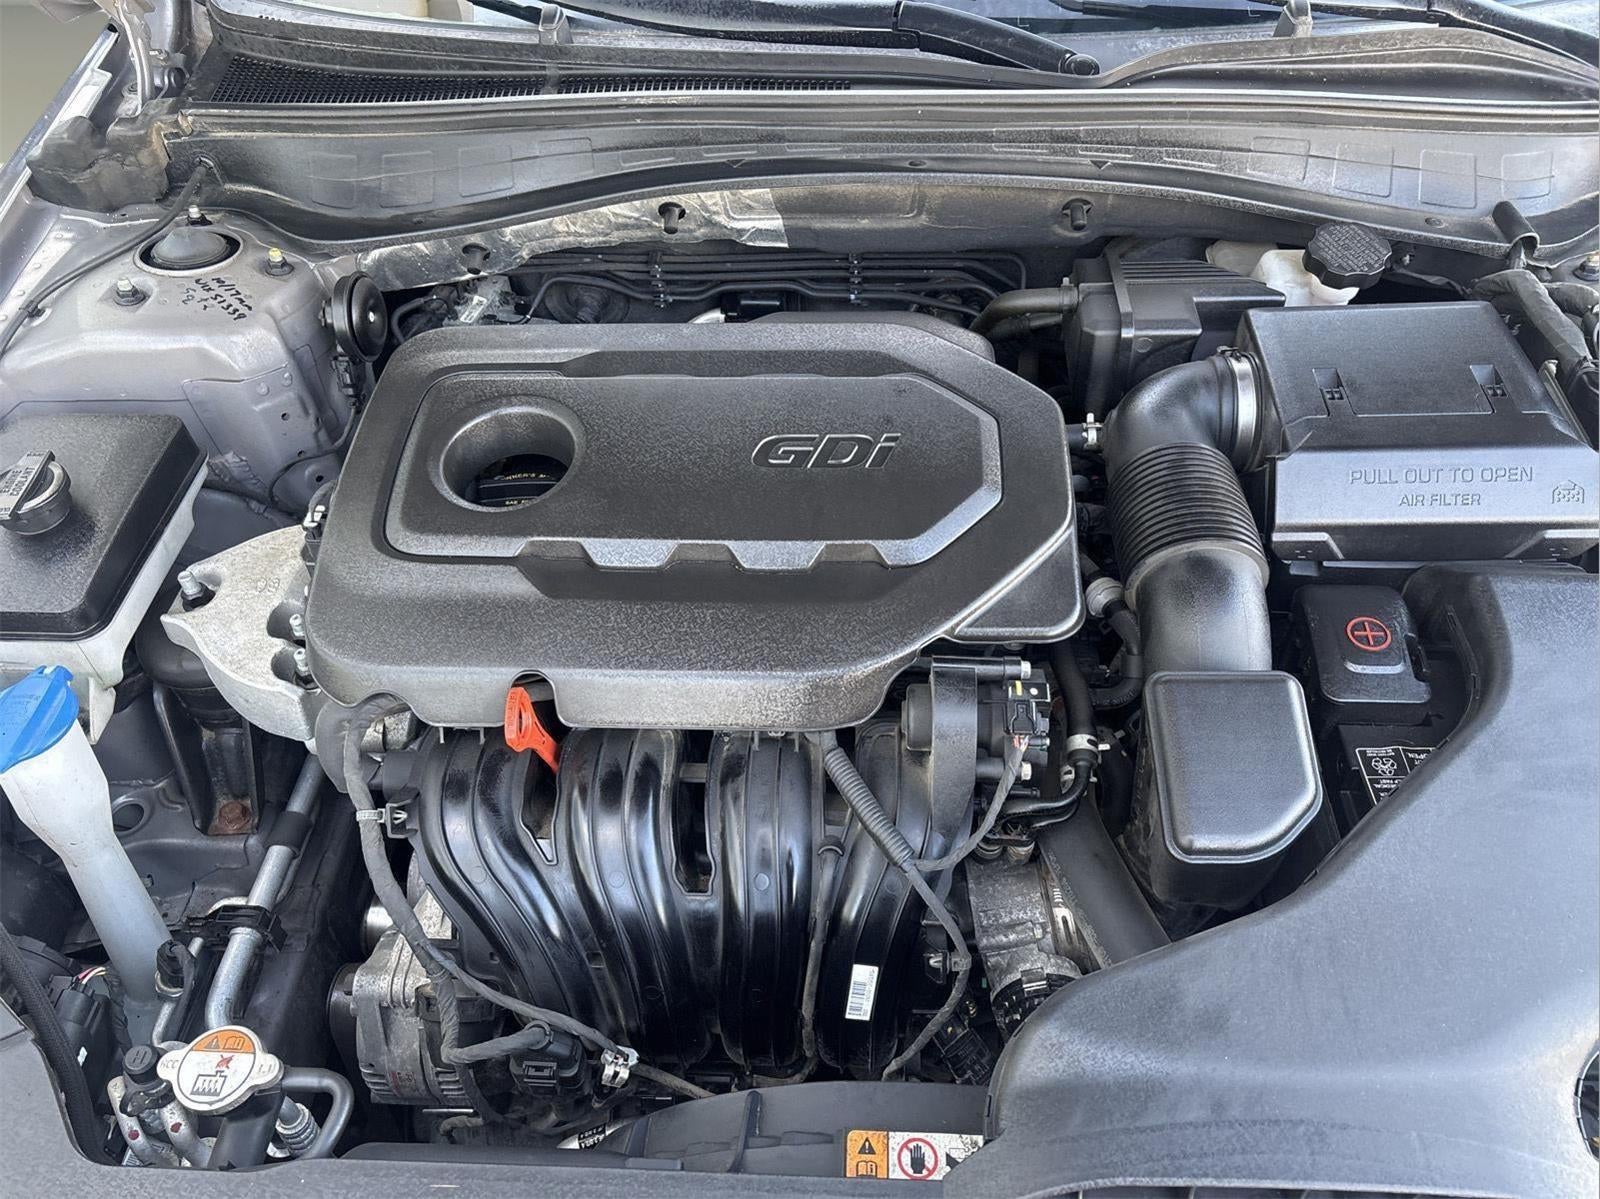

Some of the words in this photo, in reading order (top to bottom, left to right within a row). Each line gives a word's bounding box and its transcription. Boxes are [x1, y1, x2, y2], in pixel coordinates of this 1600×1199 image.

[751, 433, 901, 469] GDi
[1349, 468, 1398, 485] PULL
[1404, 467, 1443, 484] OUT
[1448, 467, 1474, 483] TO
[1480, 466, 1533, 482] OPEN
[1399, 493, 1425, 507] AIR
[1429, 493, 1481, 507] FILTER
